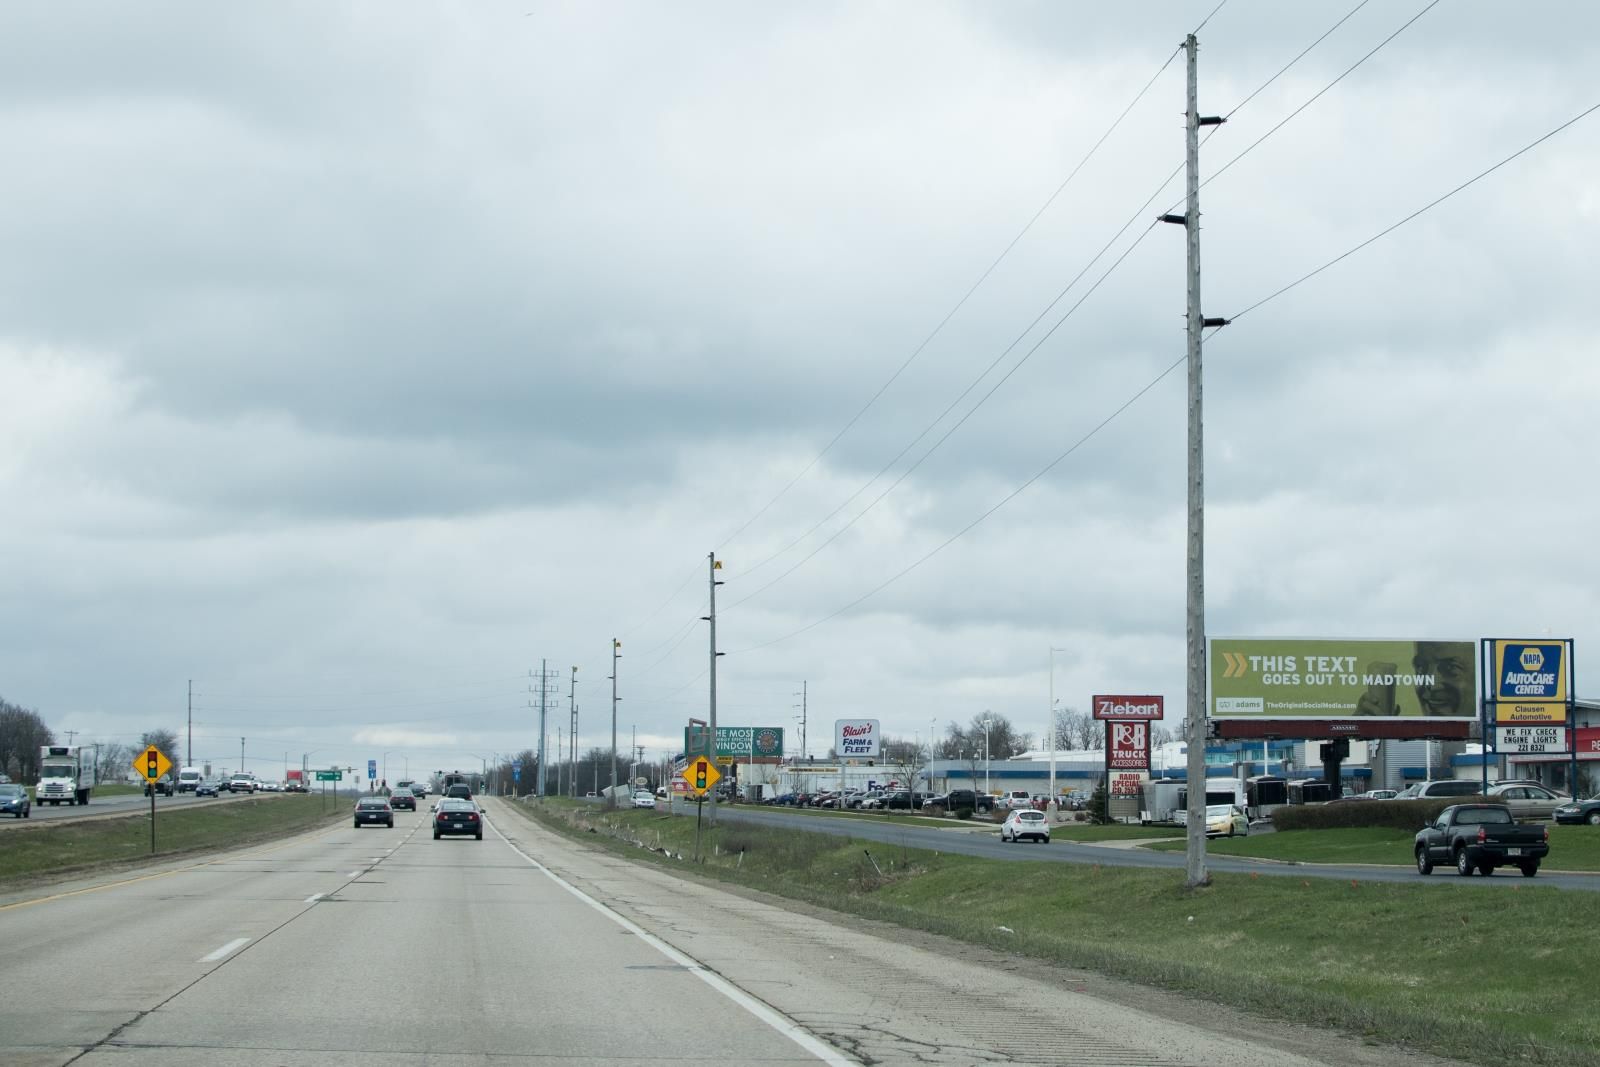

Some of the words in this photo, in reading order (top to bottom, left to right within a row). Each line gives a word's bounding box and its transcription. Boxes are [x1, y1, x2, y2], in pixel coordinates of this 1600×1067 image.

[1523, 653, 1541, 665] NAPA
[1249, 655, 1297, 673] THIS
[1303, 655, 1358, 673] TEXT
[1262, 674, 1301, 685] GOES
[1305, 674, 1334, 685] OUT
[1341, 674, 1358, 685] TO
[1362, 674, 1436, 686] MADTOWN
[1514, 684, 1545, 695] CENTER
[1099, 701, 1159, 715] Ziebart
[1514, 705, 1545, 713] Clausen
[1510, 713, 1552, 721] Automotive
[715, 729, 727, 738] HE
[842, 723, 873, 738] Blain's
[842, 738, 866, 746] FARM
[1504, 736, 1529, 744] ENGINE
[1533, 736, 1557, 744] LIGHTS
[844, 746, 871, 754] FLEET
[1518, 744, 1529, 752] 221
[1113, 750, 1146, 758] TRUCK
[1111, 759, 1147, 767] ACCESSORIES
[1119, 773, 1140, 781] RADIO
